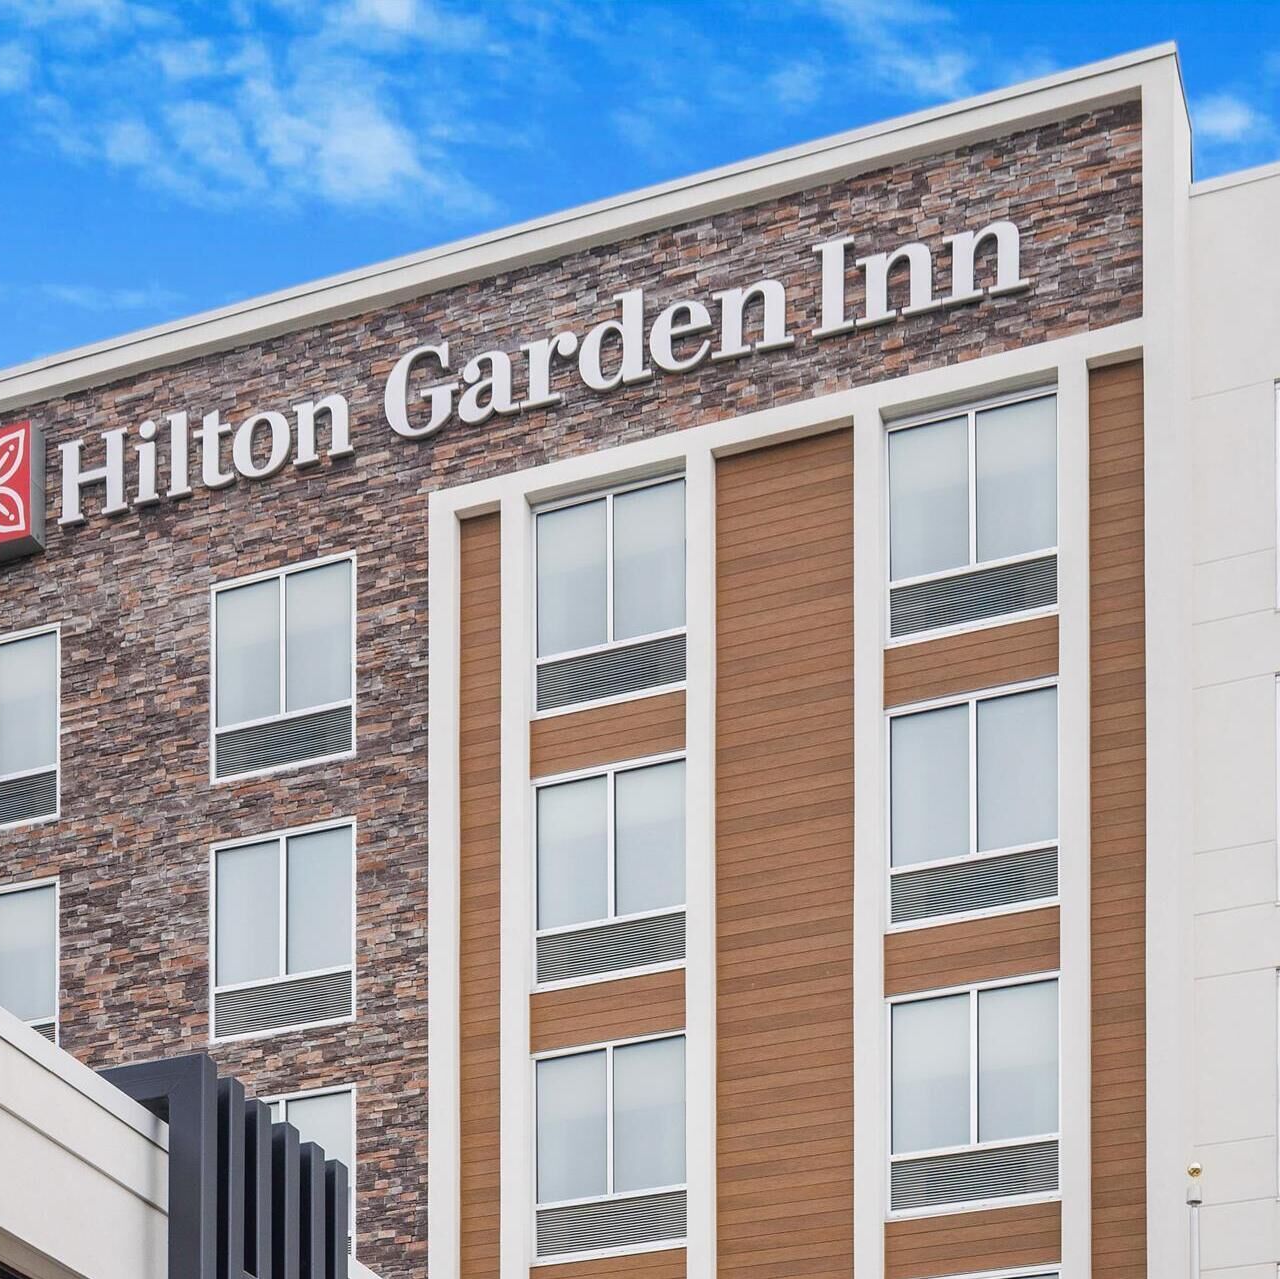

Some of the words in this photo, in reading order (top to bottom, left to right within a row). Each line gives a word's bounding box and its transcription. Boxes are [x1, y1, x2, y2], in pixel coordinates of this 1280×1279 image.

[58, 393, 355, 526] Hilton
[384, 279, 796, 440] Garden
[812, 221, 1030, 338] Inn
